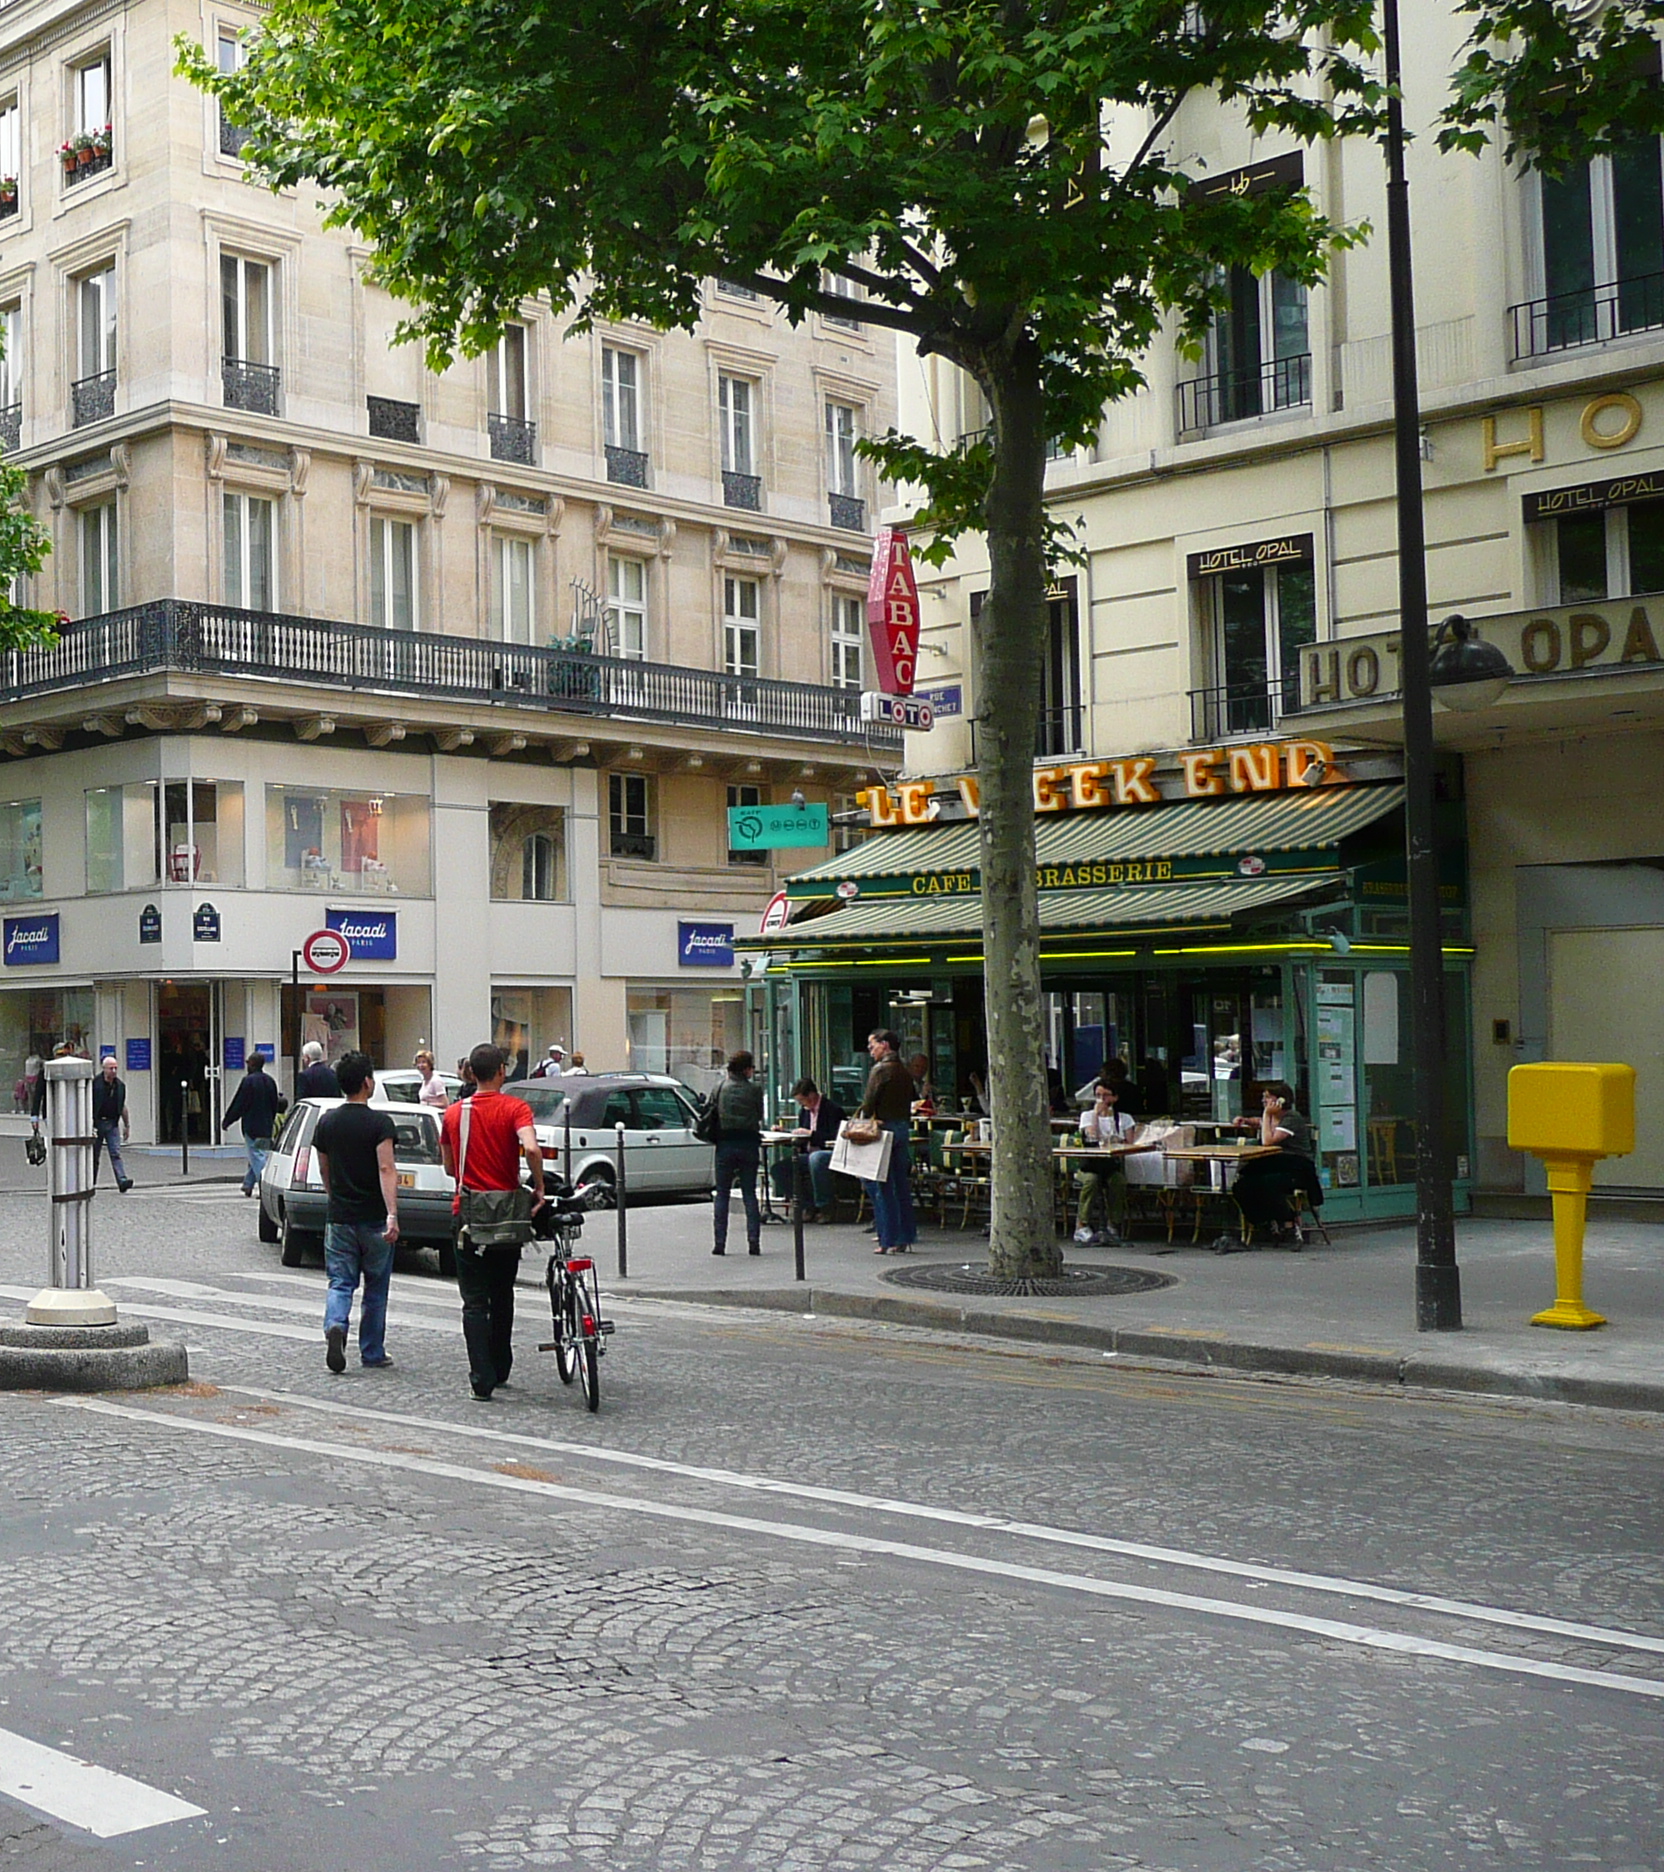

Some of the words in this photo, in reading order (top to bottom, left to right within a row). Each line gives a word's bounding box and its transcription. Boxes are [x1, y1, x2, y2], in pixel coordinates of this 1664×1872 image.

[1537, 490, 1604, 513] HOTEL
[1607, 475, 1664, 499] OPAL
[1199, 547, 1253, 570] HOTEL
[1255, 540, 1302, 560] OPAL
[888, 541, 914, 685] TABAC
[929, 691, 945, 702] RUE
[879, 700, 933, 727] LOTO
[866, 781, 933, 827] LE
[1180, 739, 1336, 797] END
[912, 874, 972, 895] CAFE
